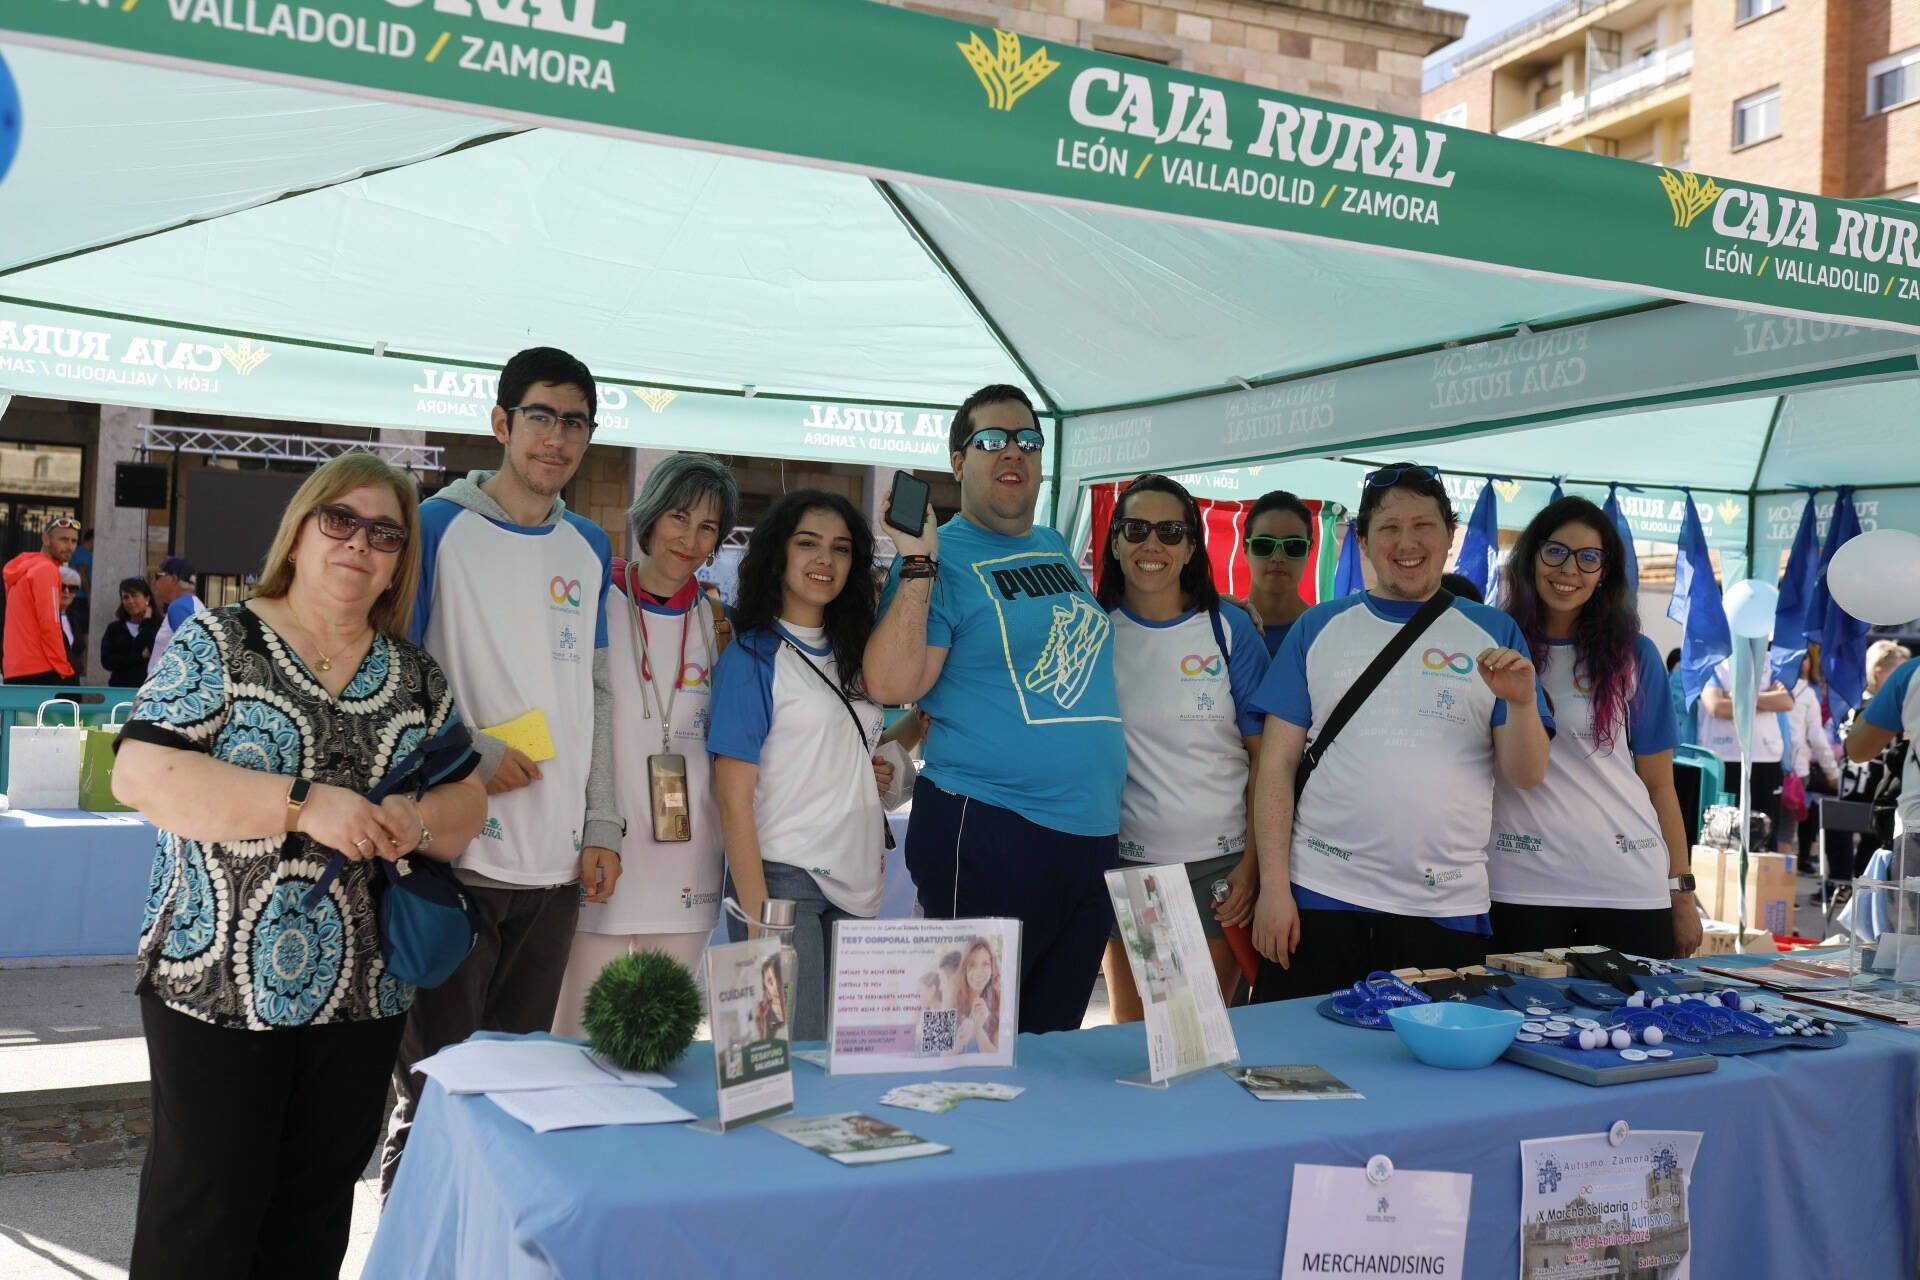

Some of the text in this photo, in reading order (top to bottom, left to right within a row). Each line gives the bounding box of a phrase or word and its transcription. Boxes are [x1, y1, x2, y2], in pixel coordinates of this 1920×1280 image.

[167, 0, 417, 58] VALLADOLID
[458, 35, 615, 93] ZAMORA
[1069, 66, 1456, 188] CAJA RURAL
[1056, 137, 1128, 177] LEÓN
[1162, 156, 1315, 207] VALLADOLID
[1341, 186, 1441, 226] ZAMORA
[1712, 188, 1820, 251] CAJA
[1705, 244, 1753, 275] LEÓN
[1775, 258, 1880, 295] VALLADOLID
[991, 563, 1085, 601] PUMA
[841, 936, 862, 945] TEST
[864, 936, 910, 944] CORPORAL
[1564, 1155, 1649, 1172] Autismo Zamora
[1548, 1206, 1585, 1221] Marcha
[1587, 1200, 1629, 1217] Solidaria
[1631, 1213, 1672, 1229] AUTISMO
[1583, 1236, 1595, 1249] de
[1597, 1234, 1616, 1248] Abril
[1618, 1232, 1630, 1245] de
[1631, 1231, 1650, 1244] 2024
[1302, 1252, 1445, 1277] MERCHANDISING
